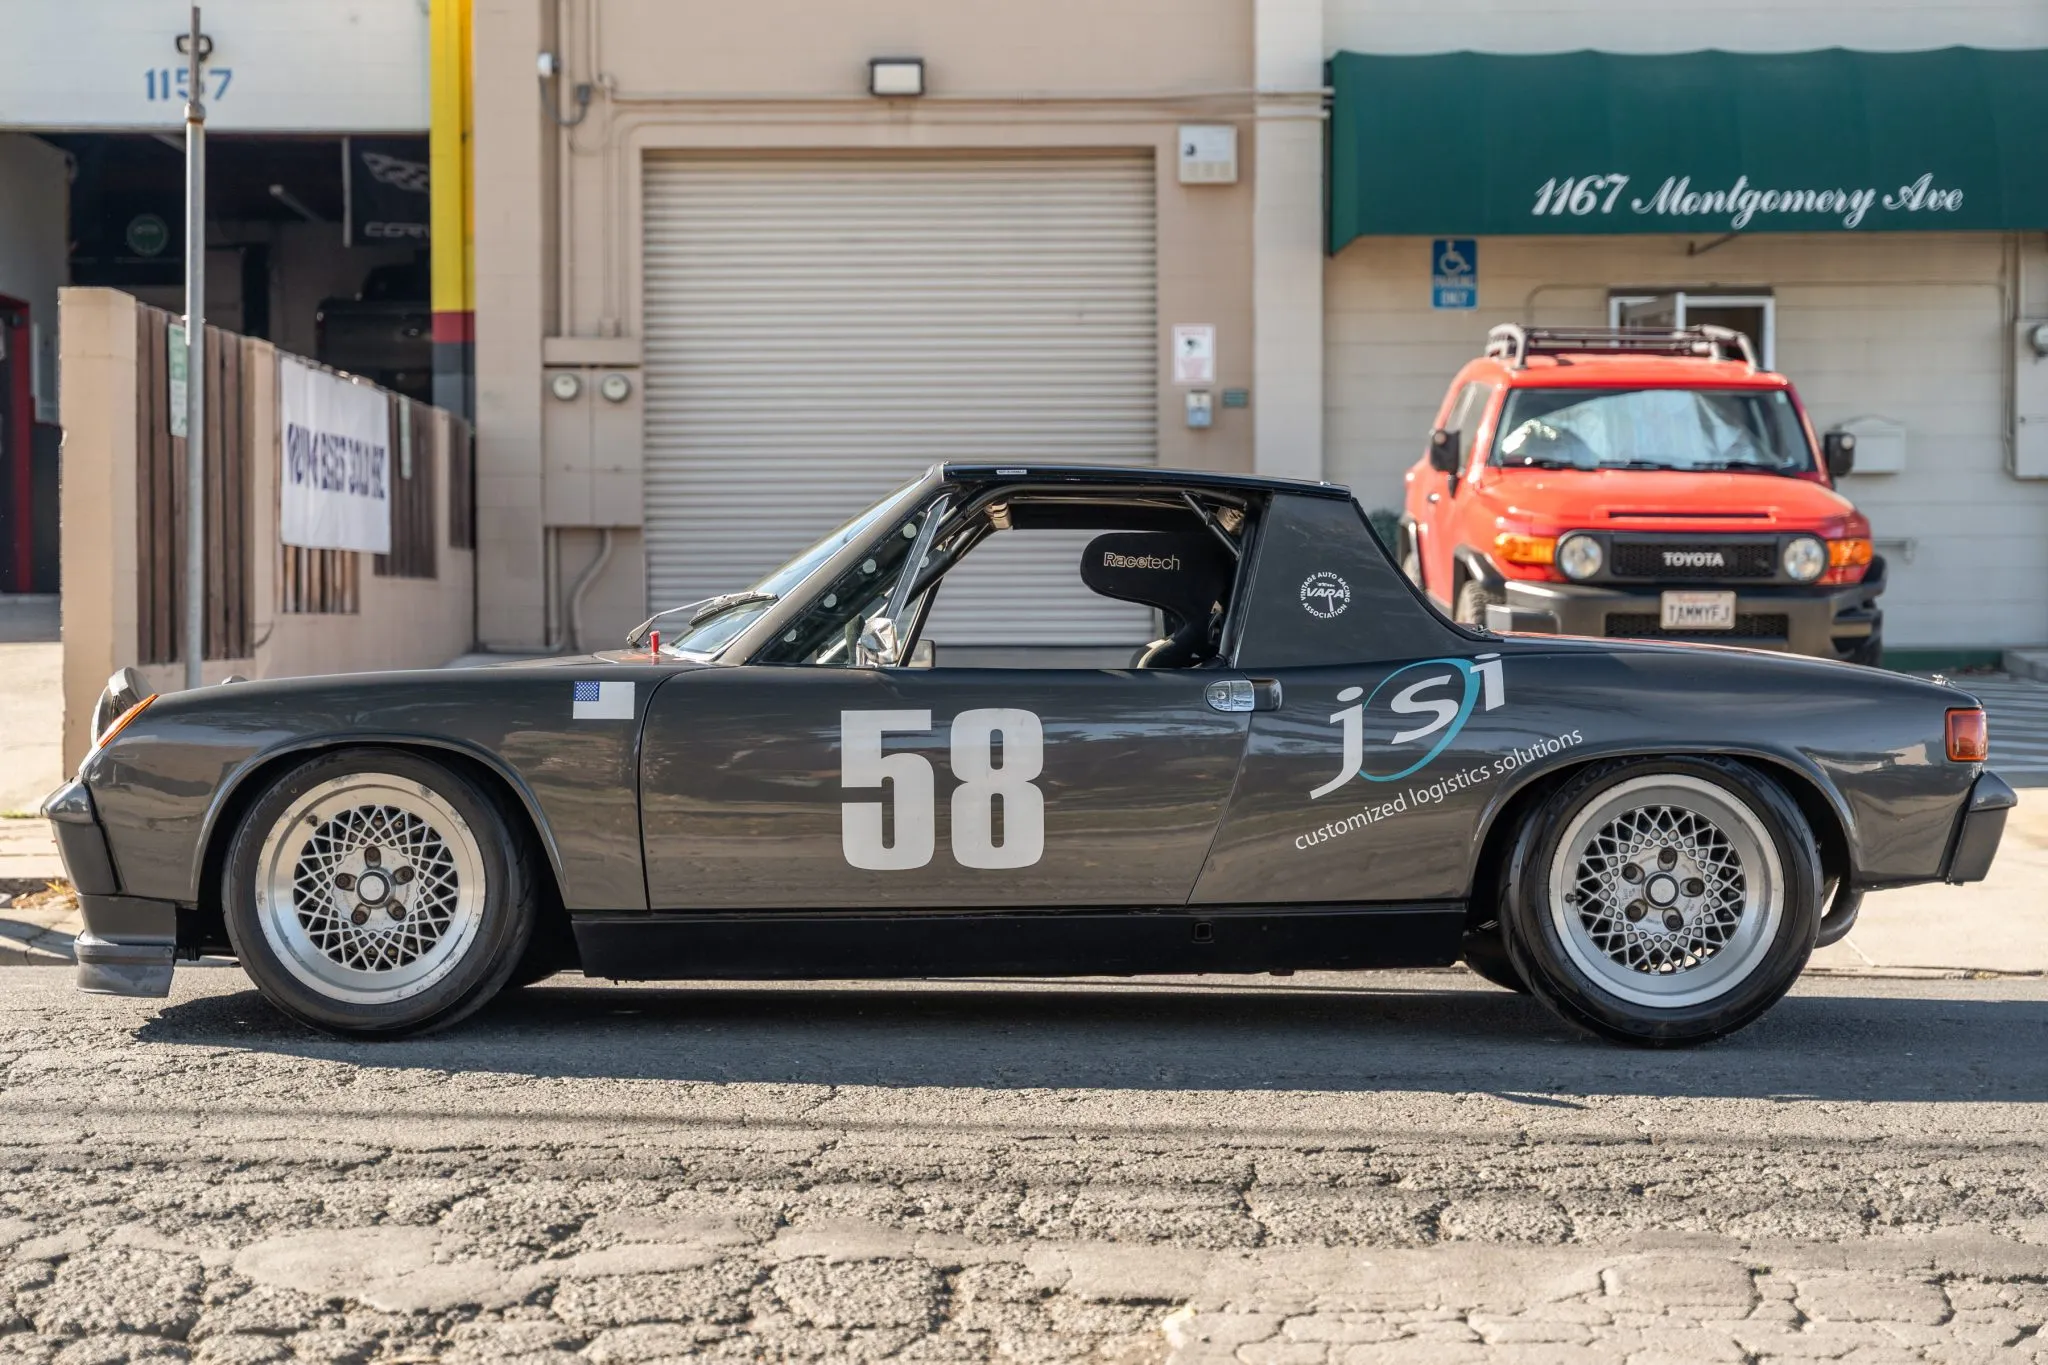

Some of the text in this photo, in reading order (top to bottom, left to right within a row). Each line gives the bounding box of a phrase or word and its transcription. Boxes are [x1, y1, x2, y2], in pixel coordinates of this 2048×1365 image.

[1531, 172, 1963, 230] 1167 Montgomery Ave
[1103, 551, 1180, 571] Racetech
[1662, 552, 1725, 567] TOYOTA
[1300, 571, 1351, 603] VINTAGE AUTO RACING
[1302, 602, 1348, 619] ASSOCIATION
[1309, 652, 1506, 800] jsi
[841, 708, 1045, 871] 58
[1295, 728, 1584, 851] customized logistics solutions
